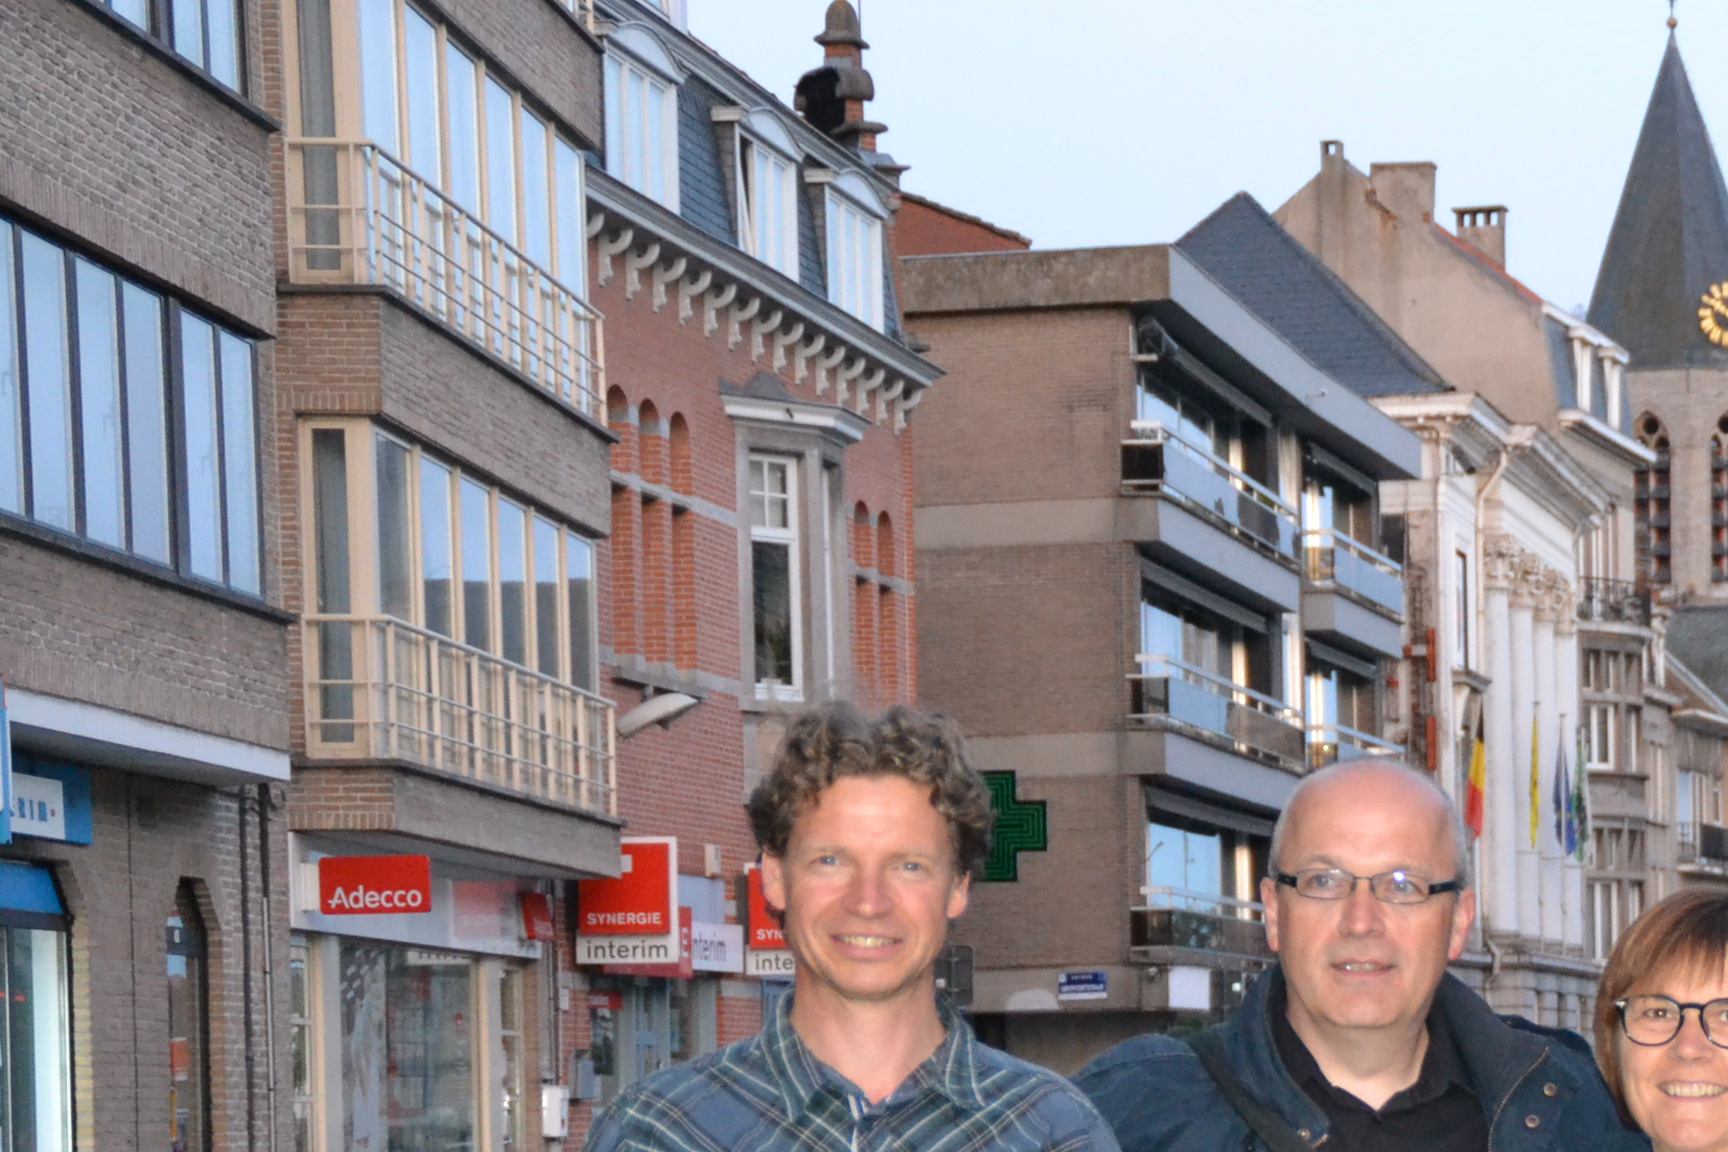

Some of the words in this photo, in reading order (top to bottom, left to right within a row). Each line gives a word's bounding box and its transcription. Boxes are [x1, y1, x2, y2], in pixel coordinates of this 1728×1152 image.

[327, 884, 423, 909] Adecco
[586, 911, 662, 926] SYNERGIE
[756, 928, 784, 941] SYN
[586, 936, 669, 960] interim
[692, 931, 727, 963] nterim
[755, 953, 795, 971] inte
